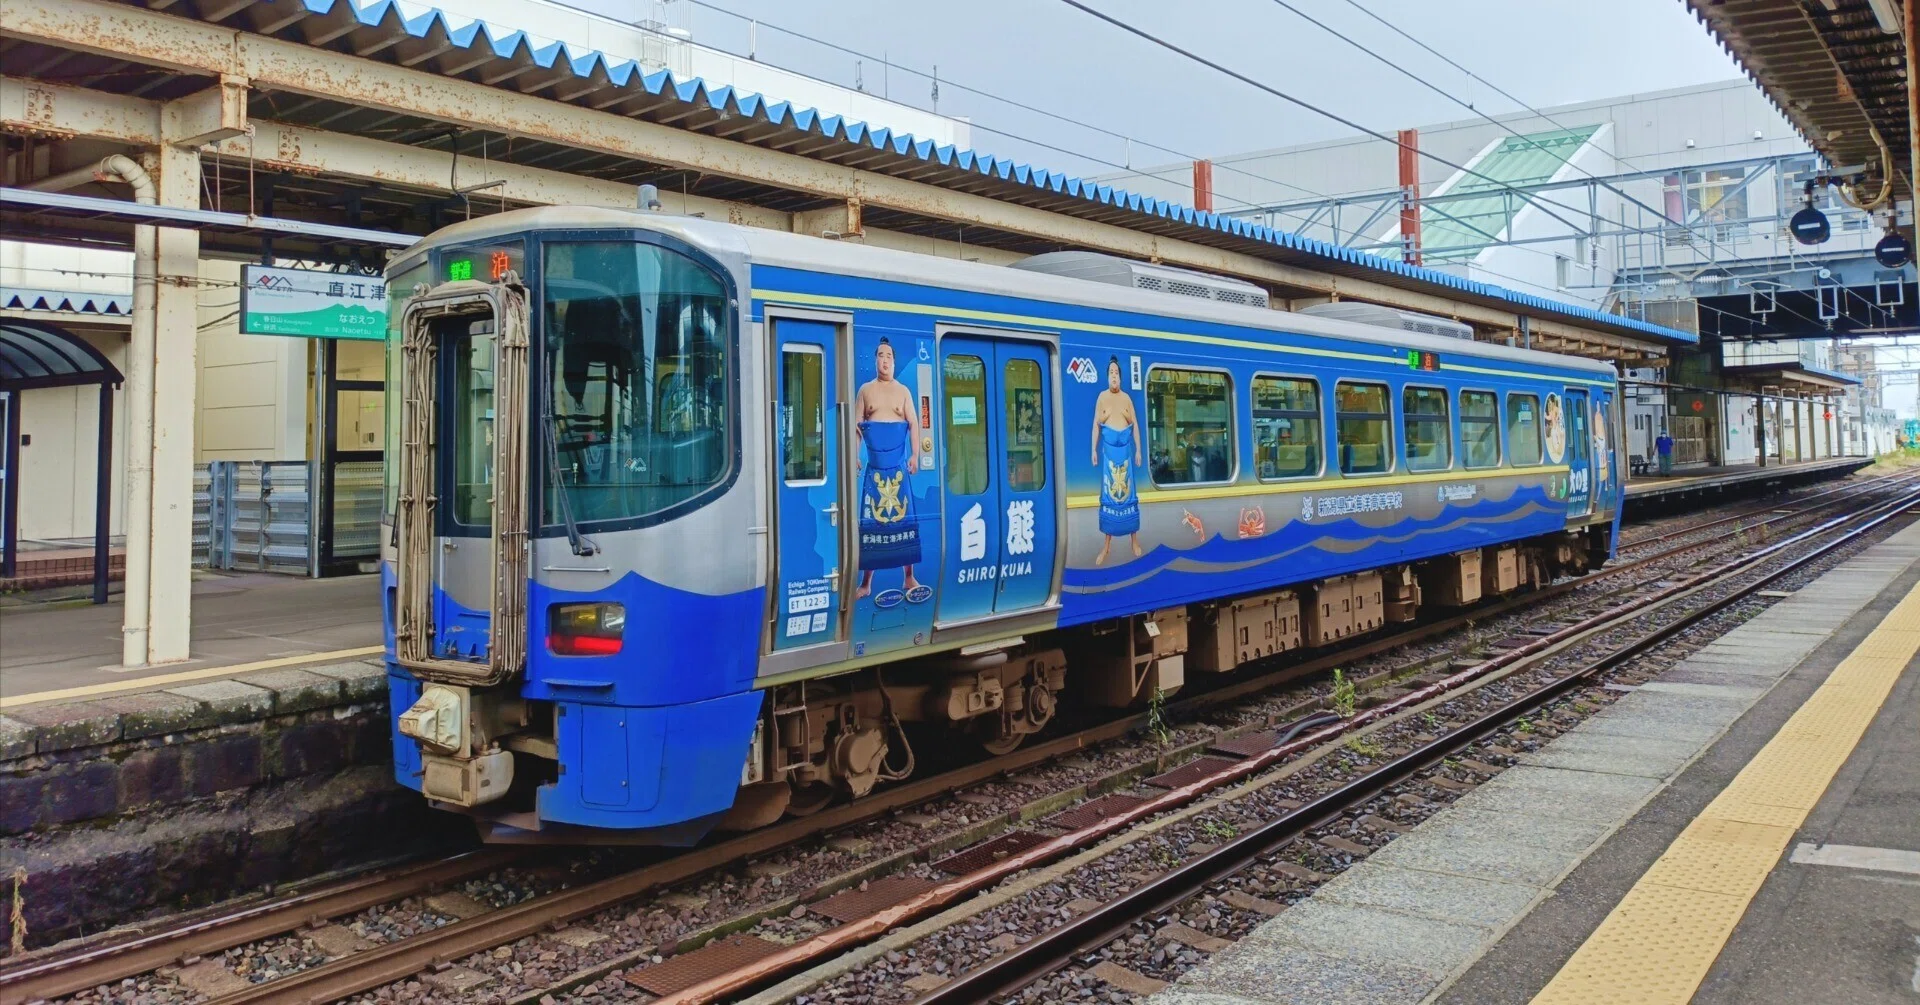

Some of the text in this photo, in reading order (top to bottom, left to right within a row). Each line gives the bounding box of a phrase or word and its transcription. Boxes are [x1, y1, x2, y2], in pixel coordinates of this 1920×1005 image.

[329, 281, 386, 300] 直江津
[339, 313, 376, 325] なおえつ
[342, 326, 371, 335] Naoetsu
[960, 500, 1035, 562] 白熊
[787, 581, 805, 589] Echigo
[788, 585, 829, 596] Railway Company
[790, 596, 827, 610] ET 122-3
